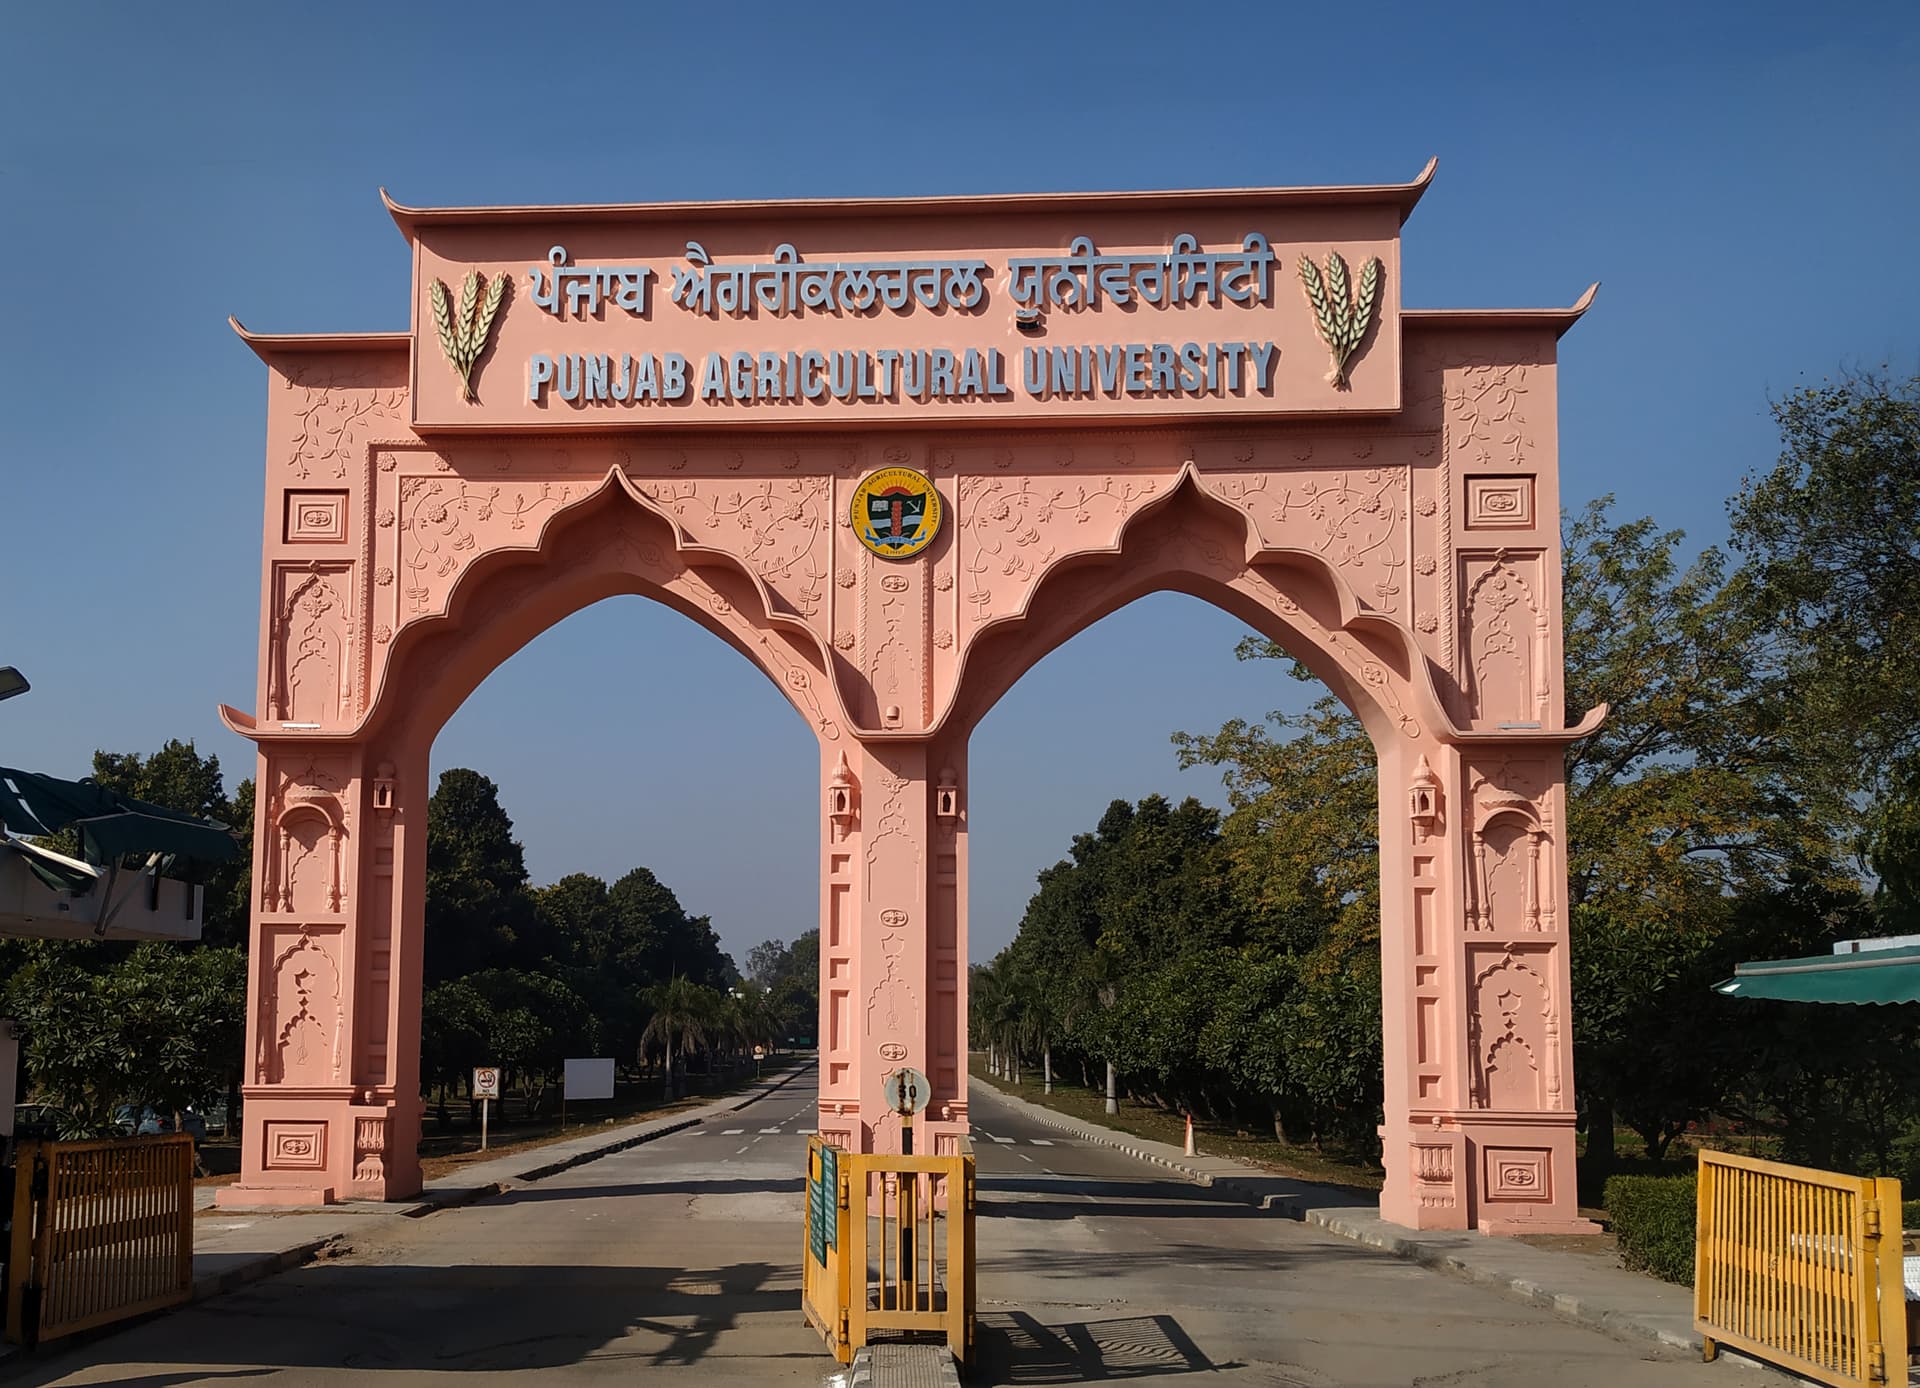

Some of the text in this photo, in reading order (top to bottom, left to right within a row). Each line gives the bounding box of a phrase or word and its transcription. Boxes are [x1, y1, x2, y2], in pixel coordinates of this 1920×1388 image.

[529, 245, 651, 314] ਪੰਜਾਬ
[672, 241, 985, 313] ਐਗਰੀਕਲਚਰਲ
[529, 342, 1275, 402] PUNJAB AGRICULTURAL UNIVERSITY
[868, 471, 921, 487] AGRICULTURAL
